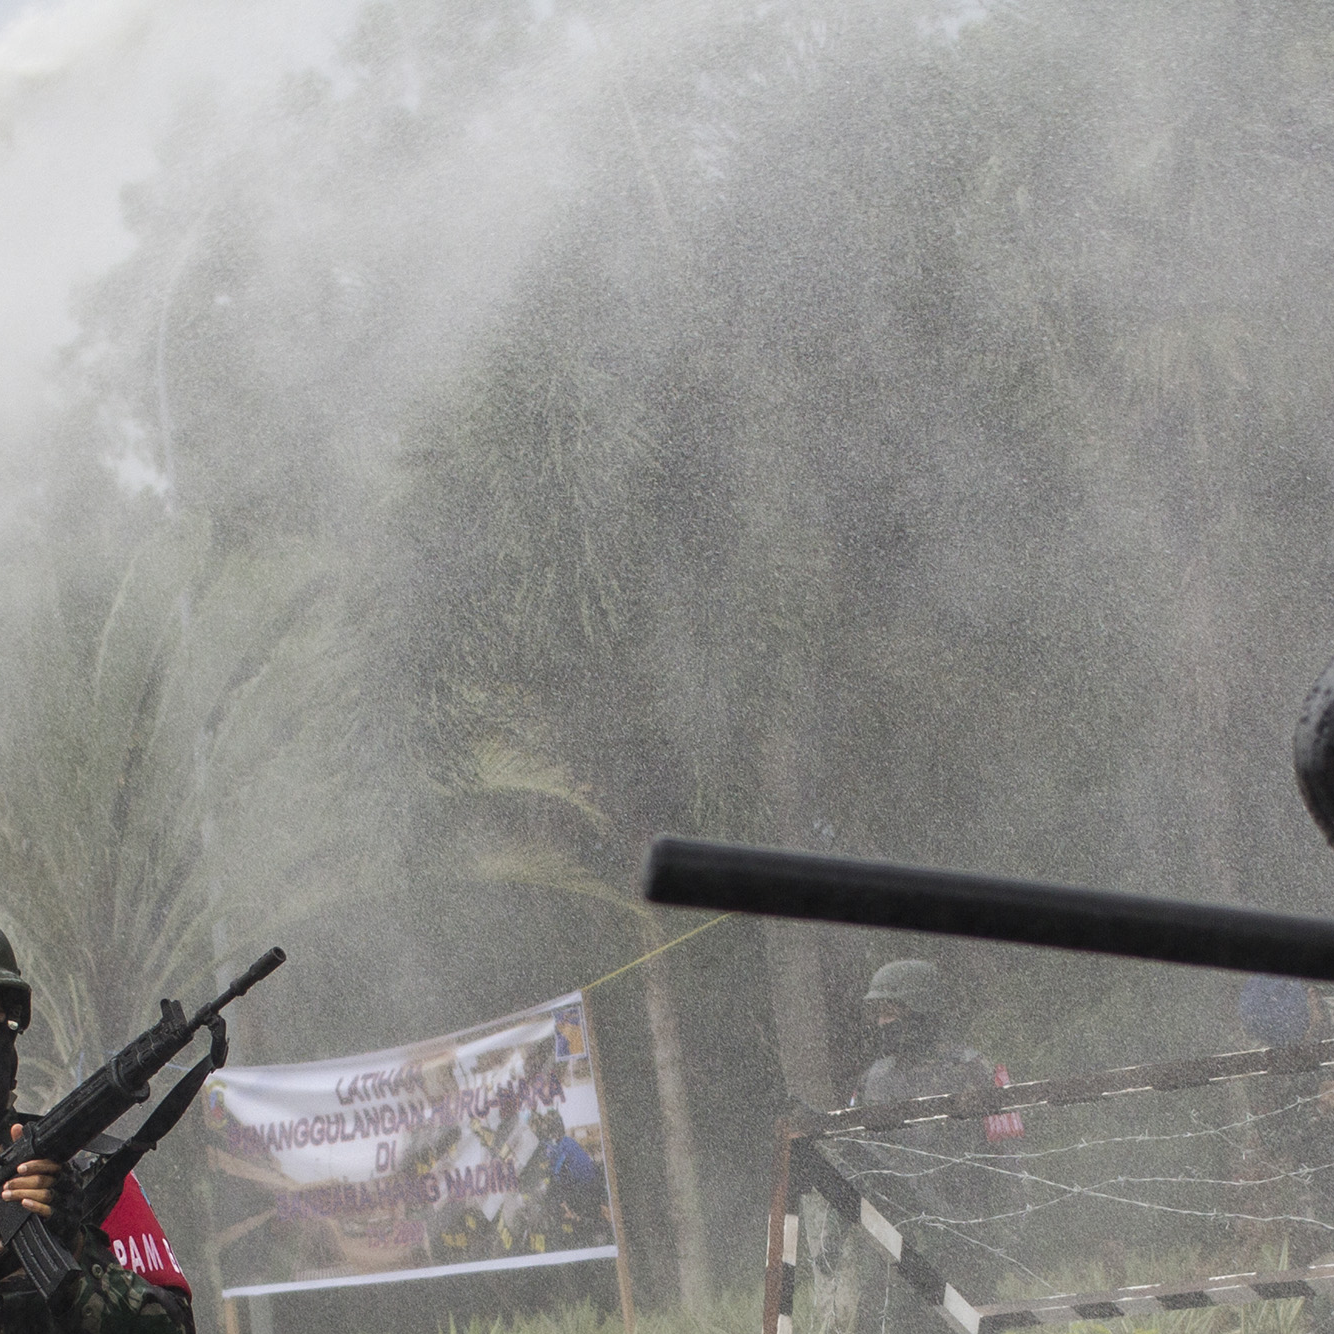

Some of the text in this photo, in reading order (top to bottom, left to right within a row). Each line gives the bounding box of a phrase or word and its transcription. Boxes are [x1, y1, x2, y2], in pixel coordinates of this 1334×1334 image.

[335, 1063, 424, 1106] LATIHAN
[375, 1140, 397, 1174] DI
[113, 1233, 164, 1274] PAM
